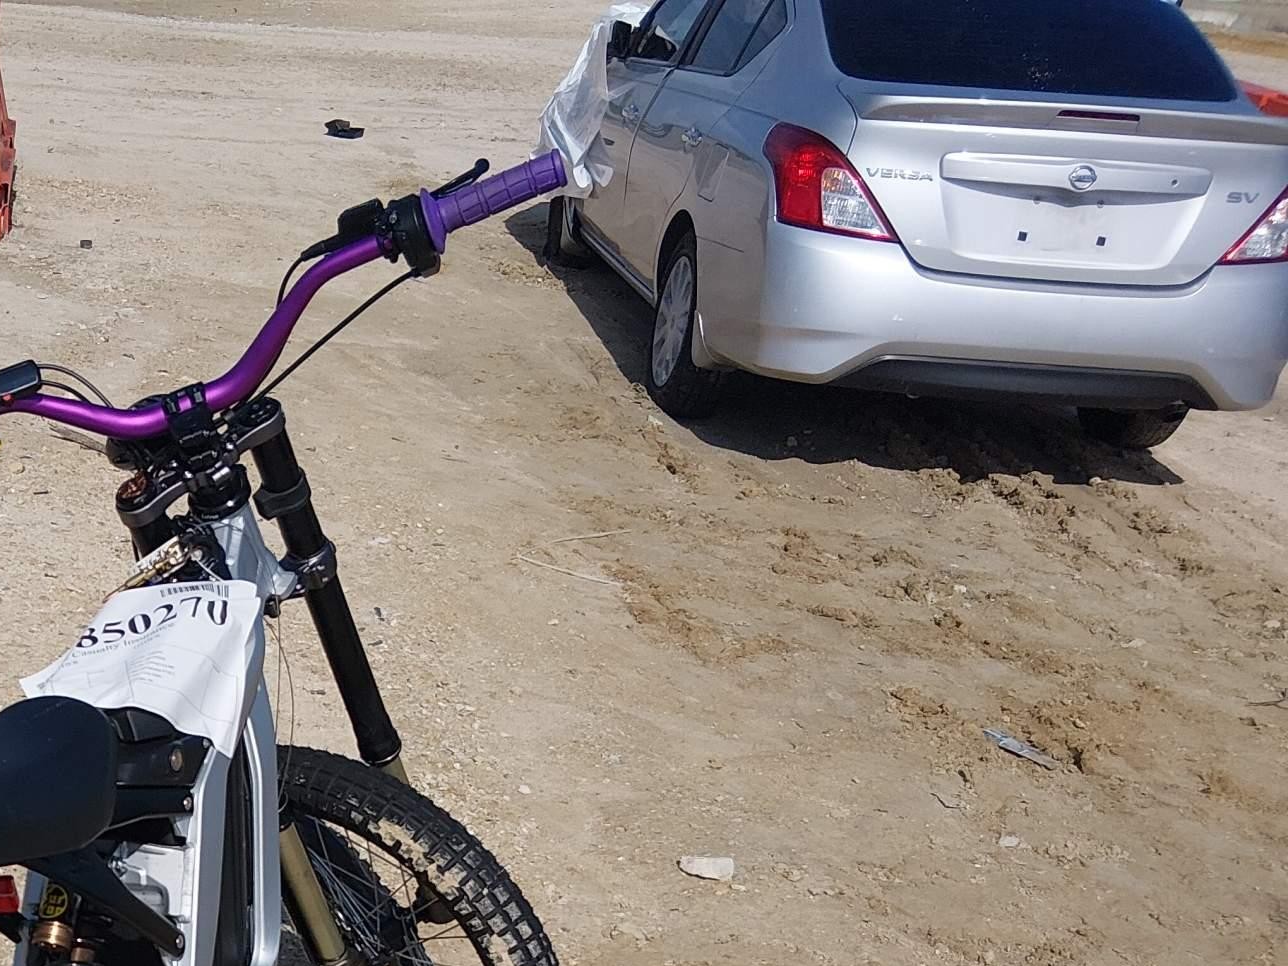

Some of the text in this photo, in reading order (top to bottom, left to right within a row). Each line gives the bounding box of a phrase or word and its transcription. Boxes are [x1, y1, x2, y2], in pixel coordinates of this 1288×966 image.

[866, 167, 933, 182] VERSA
[1226, 191, 1260, 204] SV
[75, 596, 229, 648] 850270
